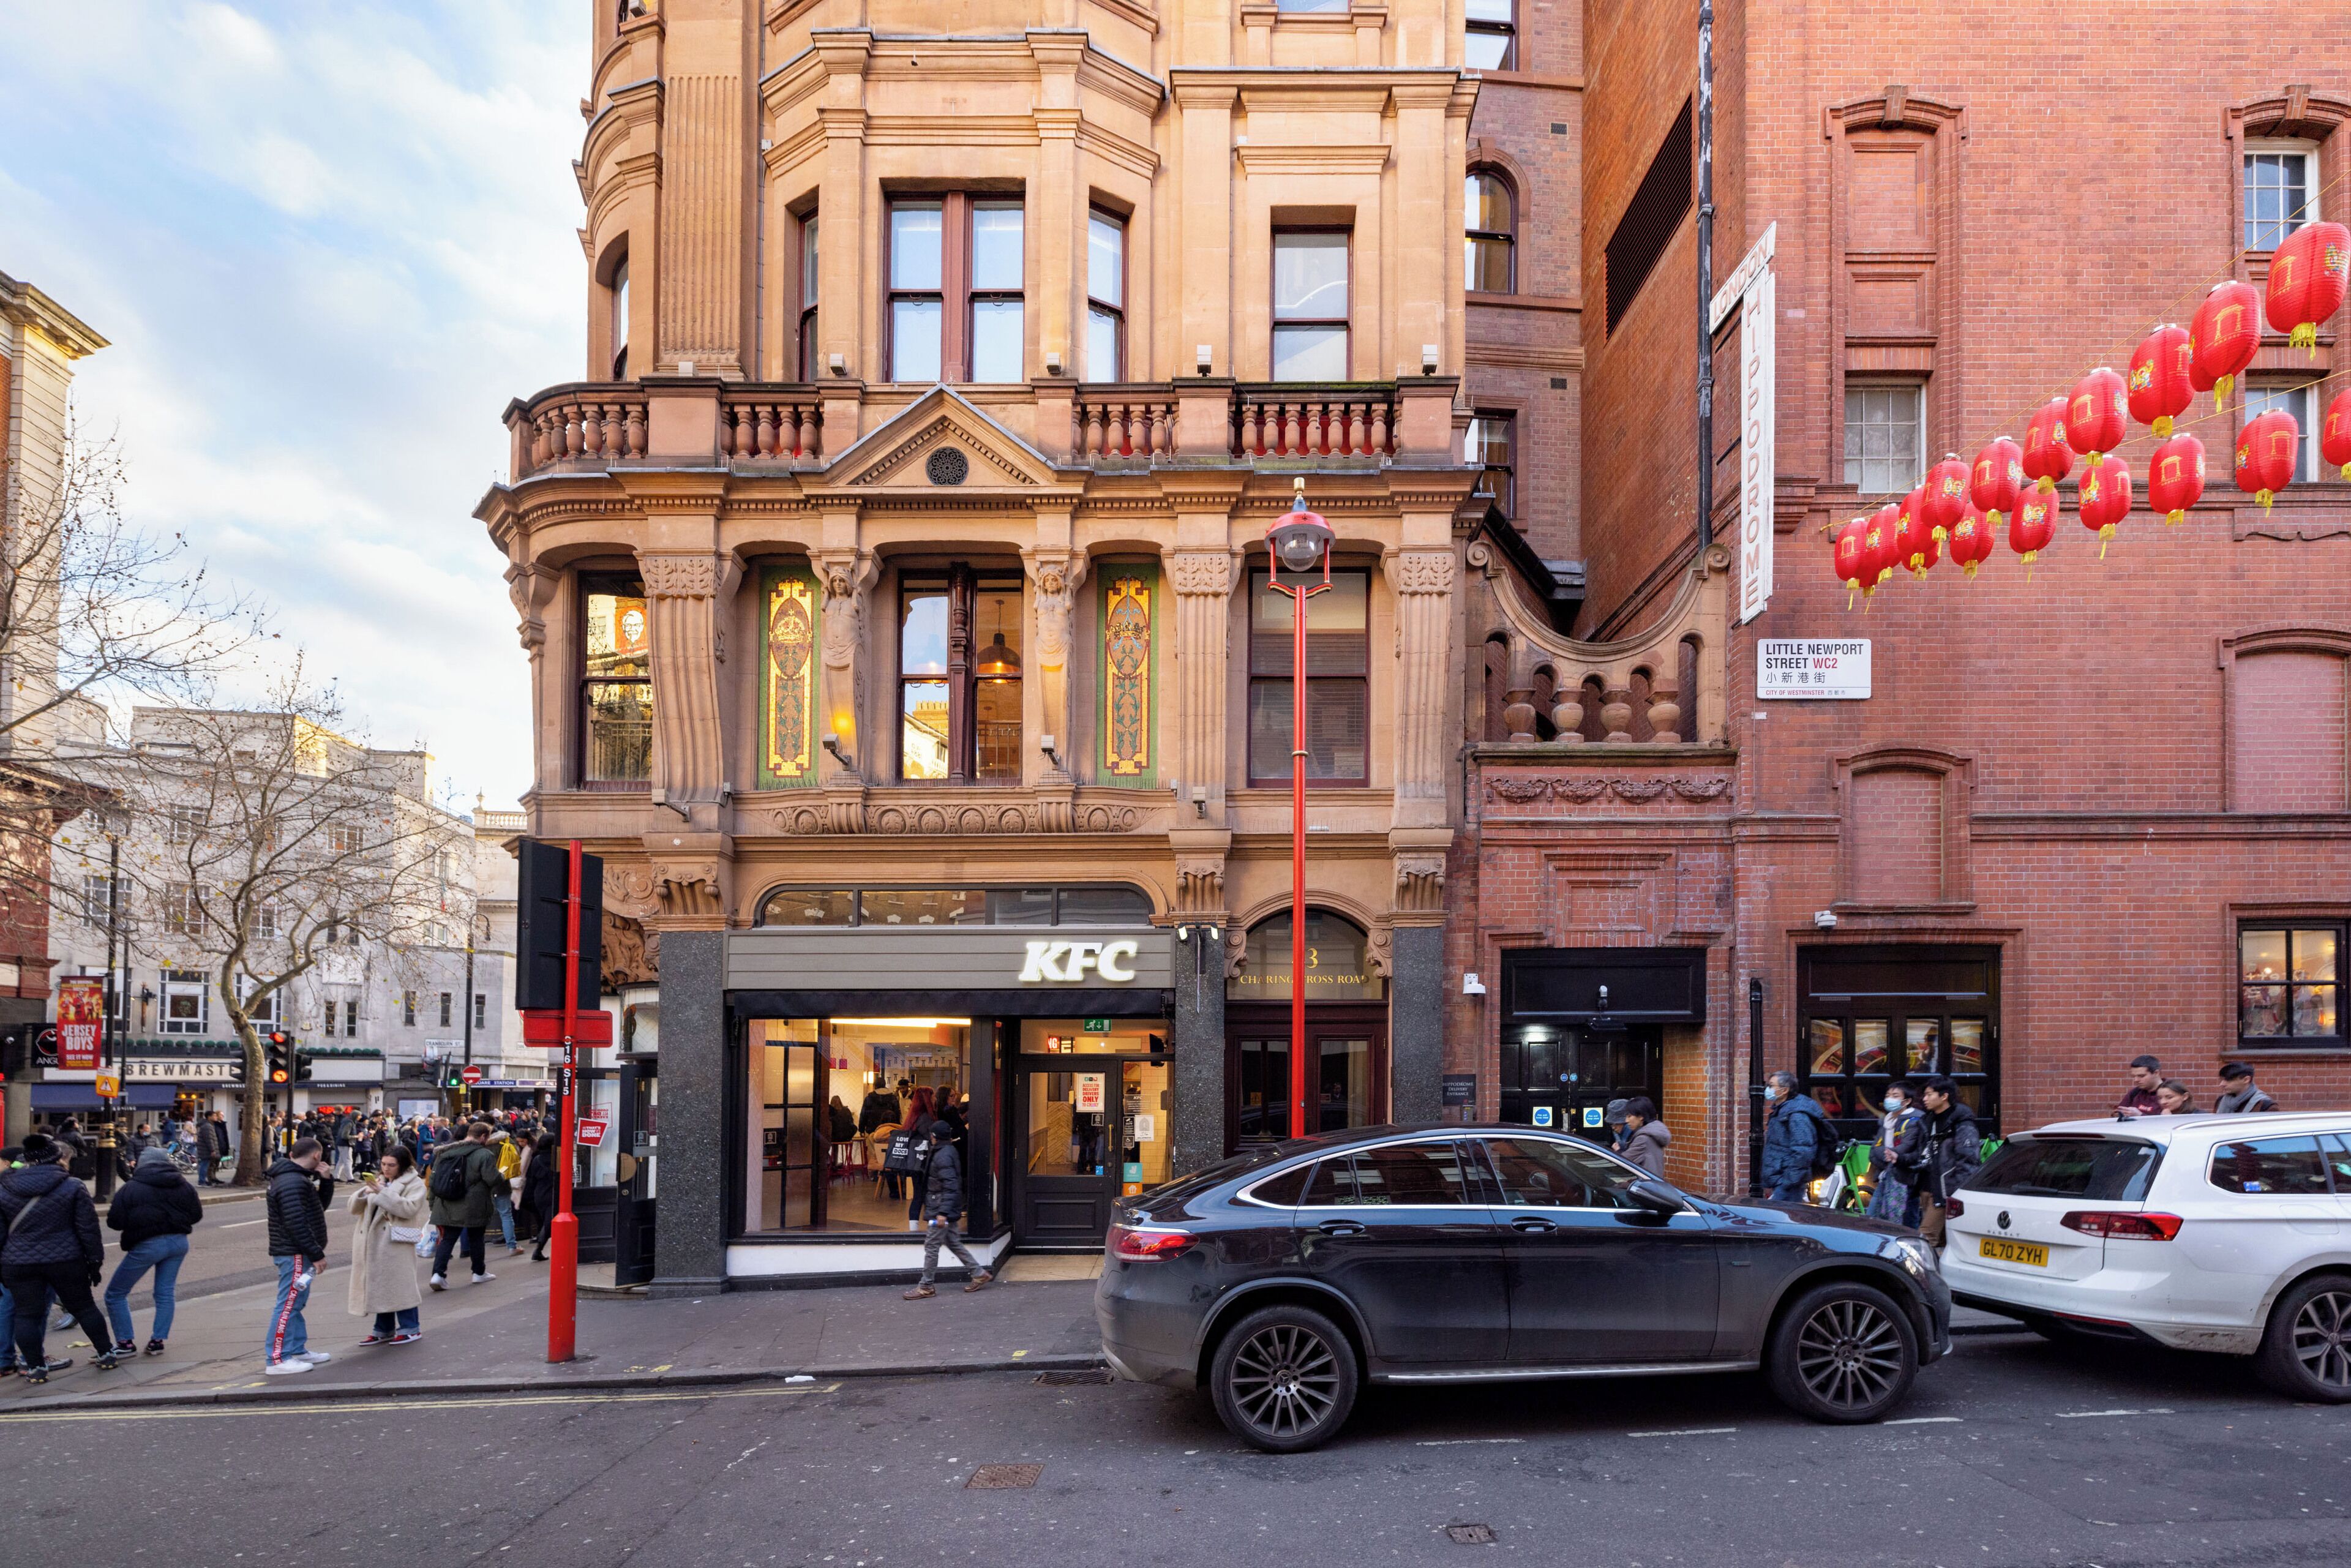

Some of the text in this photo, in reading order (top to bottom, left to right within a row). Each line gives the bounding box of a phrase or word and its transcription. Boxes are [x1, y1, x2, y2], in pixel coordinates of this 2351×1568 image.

[1714, 235, 1768, 323] LONDON
[1745, 288, 1761, 610] HIPPODROME
[1766, 643, 1864, 655] LITTLE NEWPORT
[1766, 658, 1838, 669] STREET WC2
[1766, 672, 1826, 683] 小新港街
[1018, 941, 1138, 981] KFC
[1304, 975, 1333, 984] ROSS
[62, 1024, 97, 1037] JERSEY
[66, 1037, 94, 1051] BOYS
[126, 1065, 236, 1076] BREWMASTE
[1983, 1241, 2042, 1264] GL70 ZYH
